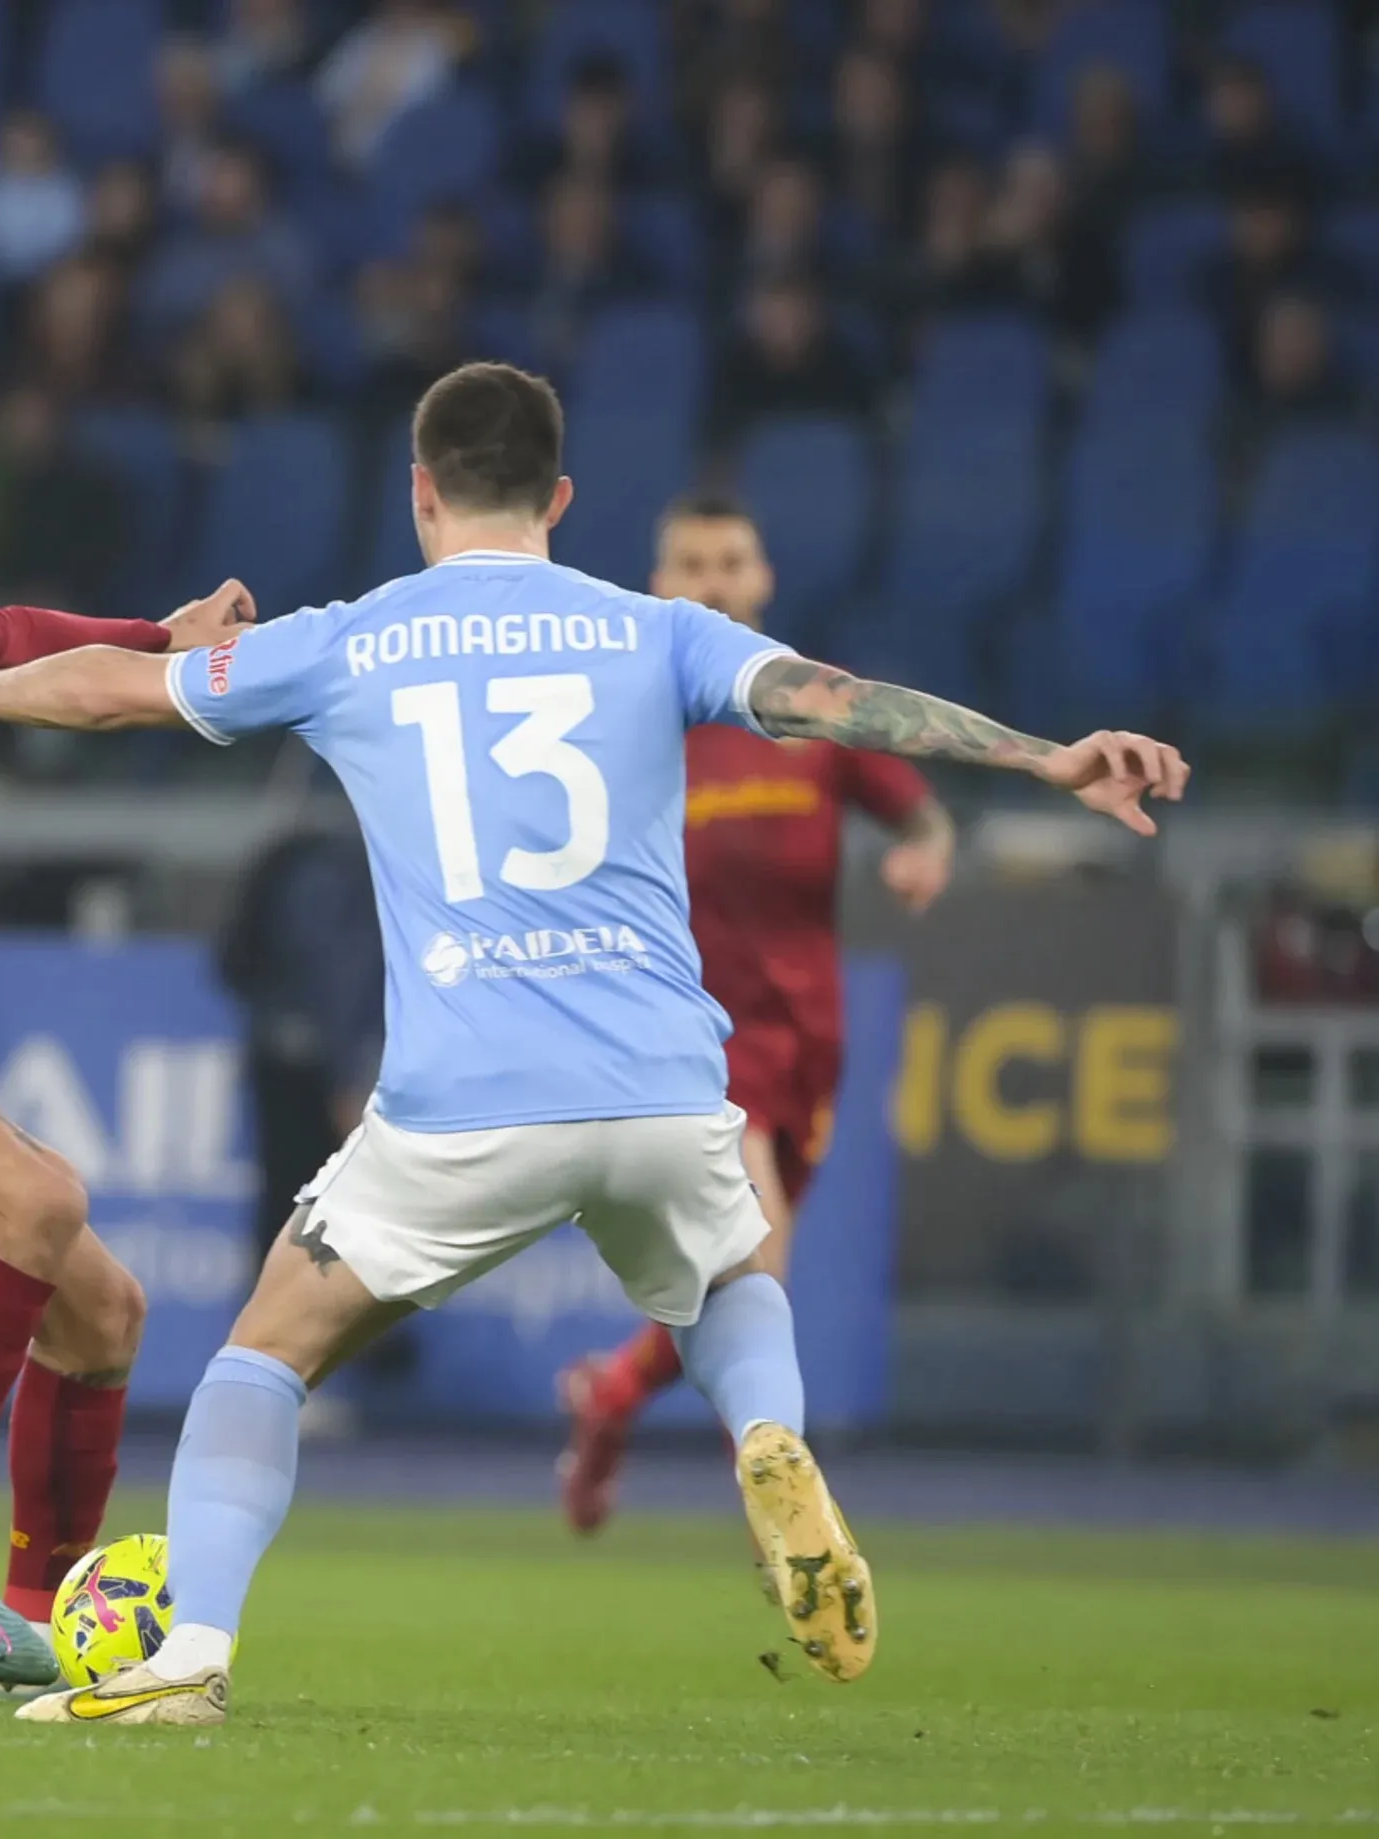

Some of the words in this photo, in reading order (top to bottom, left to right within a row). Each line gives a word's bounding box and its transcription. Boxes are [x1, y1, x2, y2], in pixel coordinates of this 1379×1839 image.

[346, 612, 639, 677] ROMAGNOLI
[391, 674, 609, 903] 13
[471, 924, 646, 960] PAIDEIA
